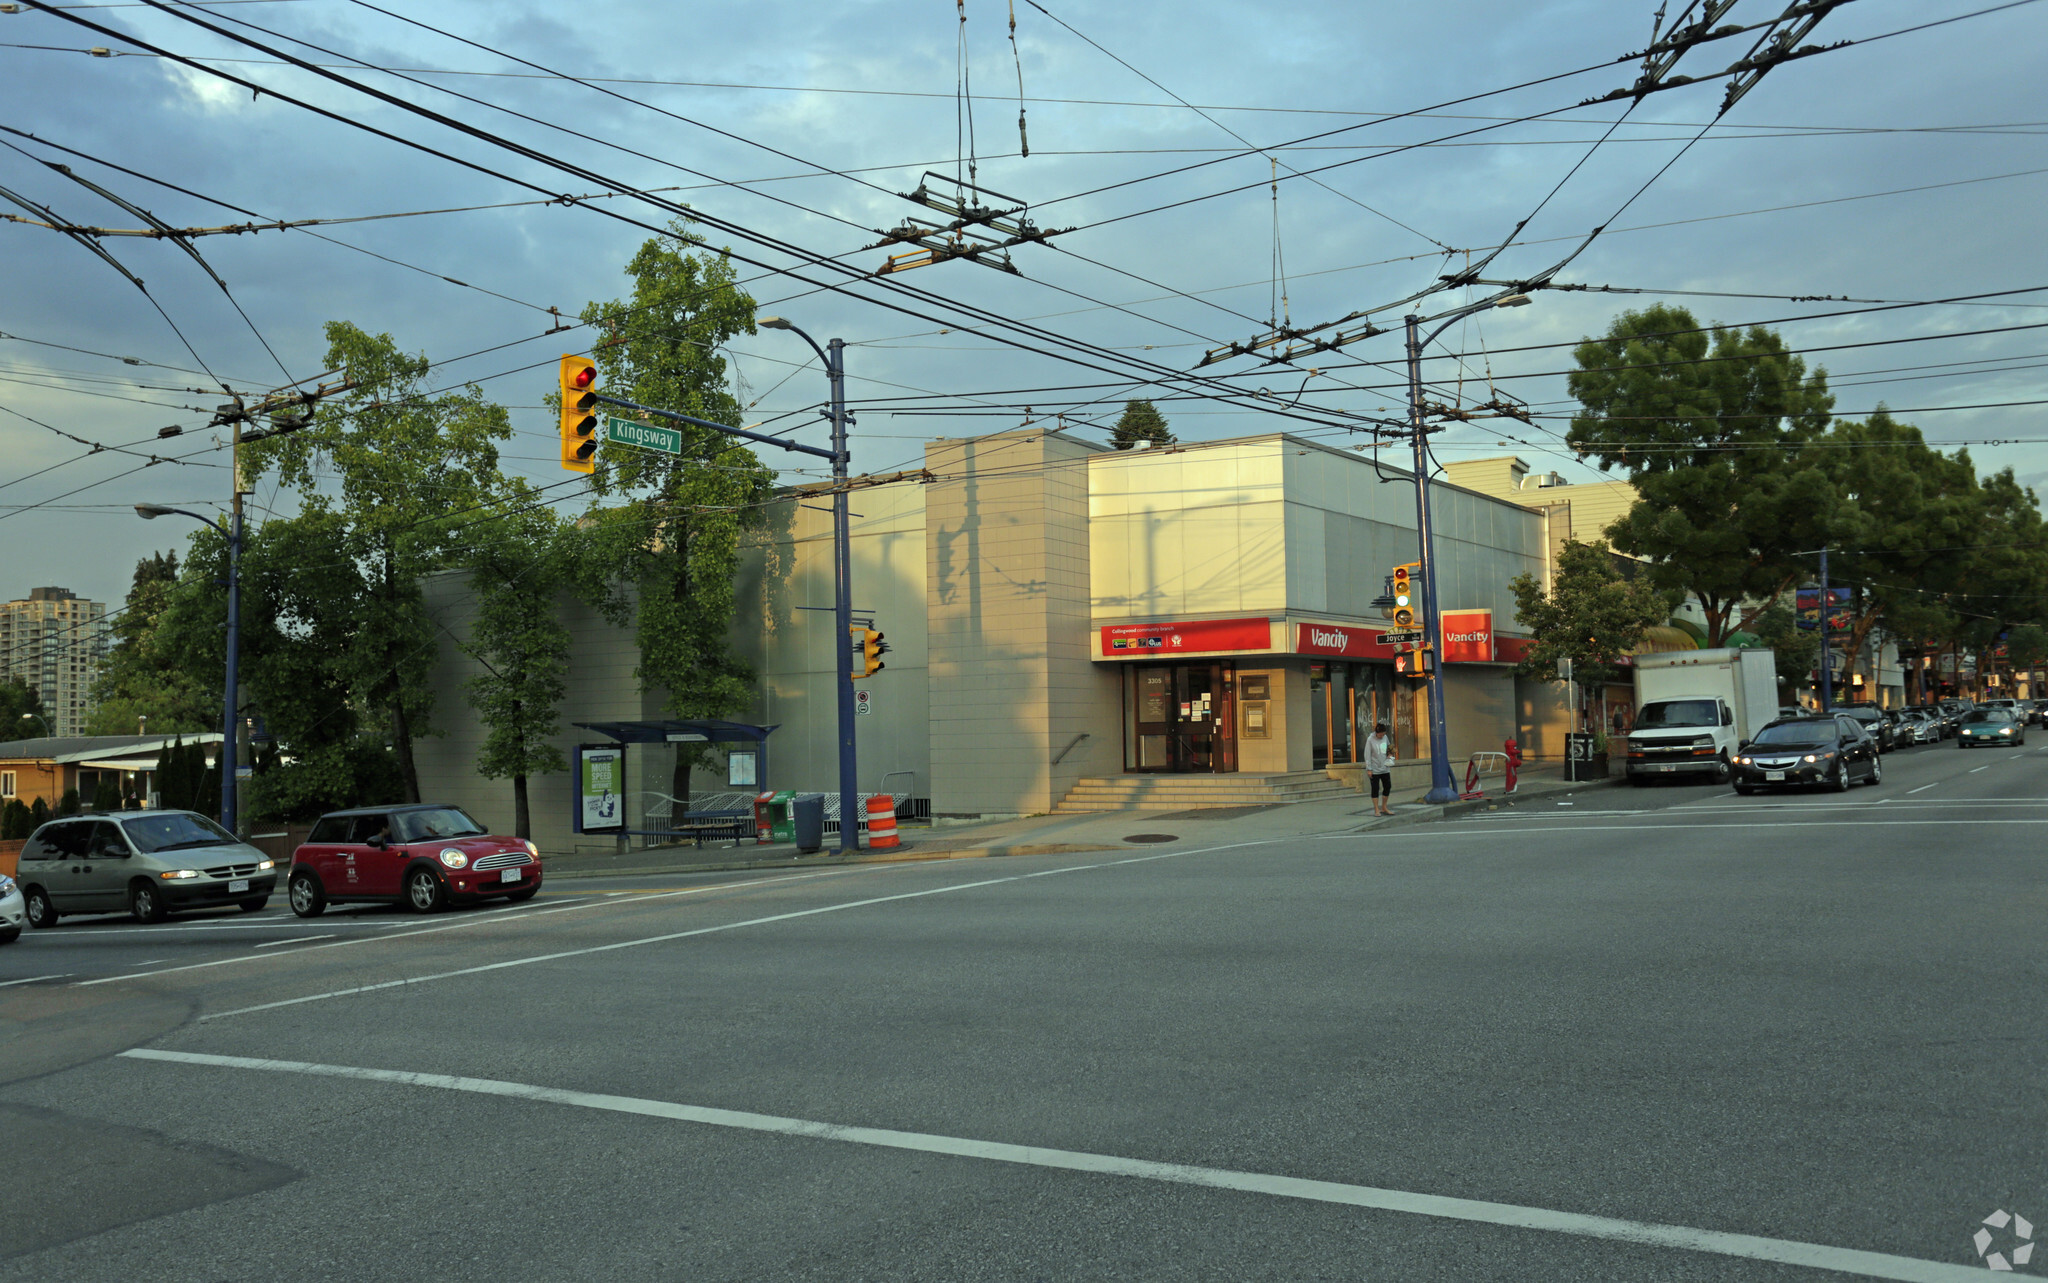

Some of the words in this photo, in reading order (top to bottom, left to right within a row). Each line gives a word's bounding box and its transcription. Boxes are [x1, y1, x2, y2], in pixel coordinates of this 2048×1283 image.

[617, 422, 673, 450] Kingsway
[1311, 628, 1348, 653] Vancity
[1386, 634, 1405, 643] Joyce
[1446, 631, 1488, 644] Vancity
[591, 763, 612, 772] MORE
[591, 772, 612, 780] SPEED
